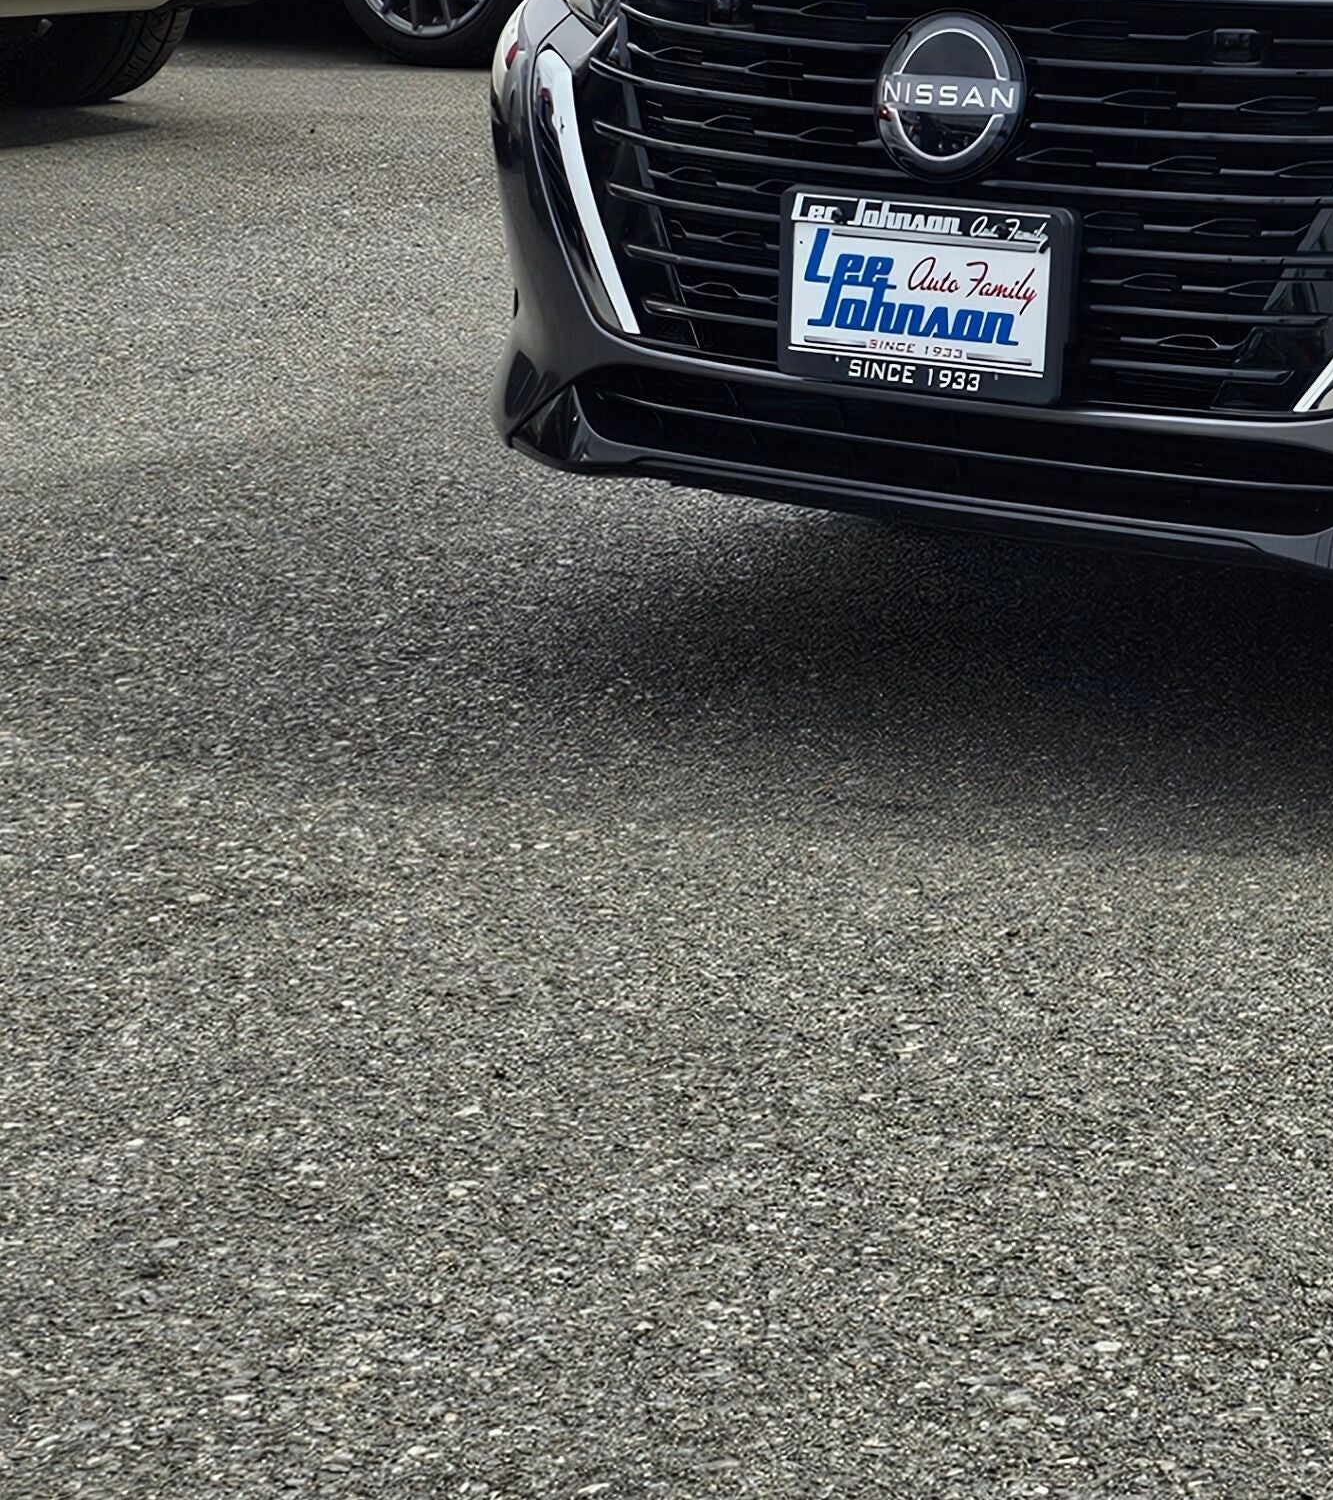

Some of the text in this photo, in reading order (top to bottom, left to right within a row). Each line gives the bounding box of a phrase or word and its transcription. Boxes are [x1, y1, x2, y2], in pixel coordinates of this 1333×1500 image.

[883, 80, 1014, 108] NISSAN
[847, 199, 963, 235] Johnson
[804, 228, 1038, 315] Lee Auto Family
[808, 282, 1019, 346] Johnson
[869, 339, 963, 359] SINCE 1933
[849, 360, 980, 392] SINCE 1933
